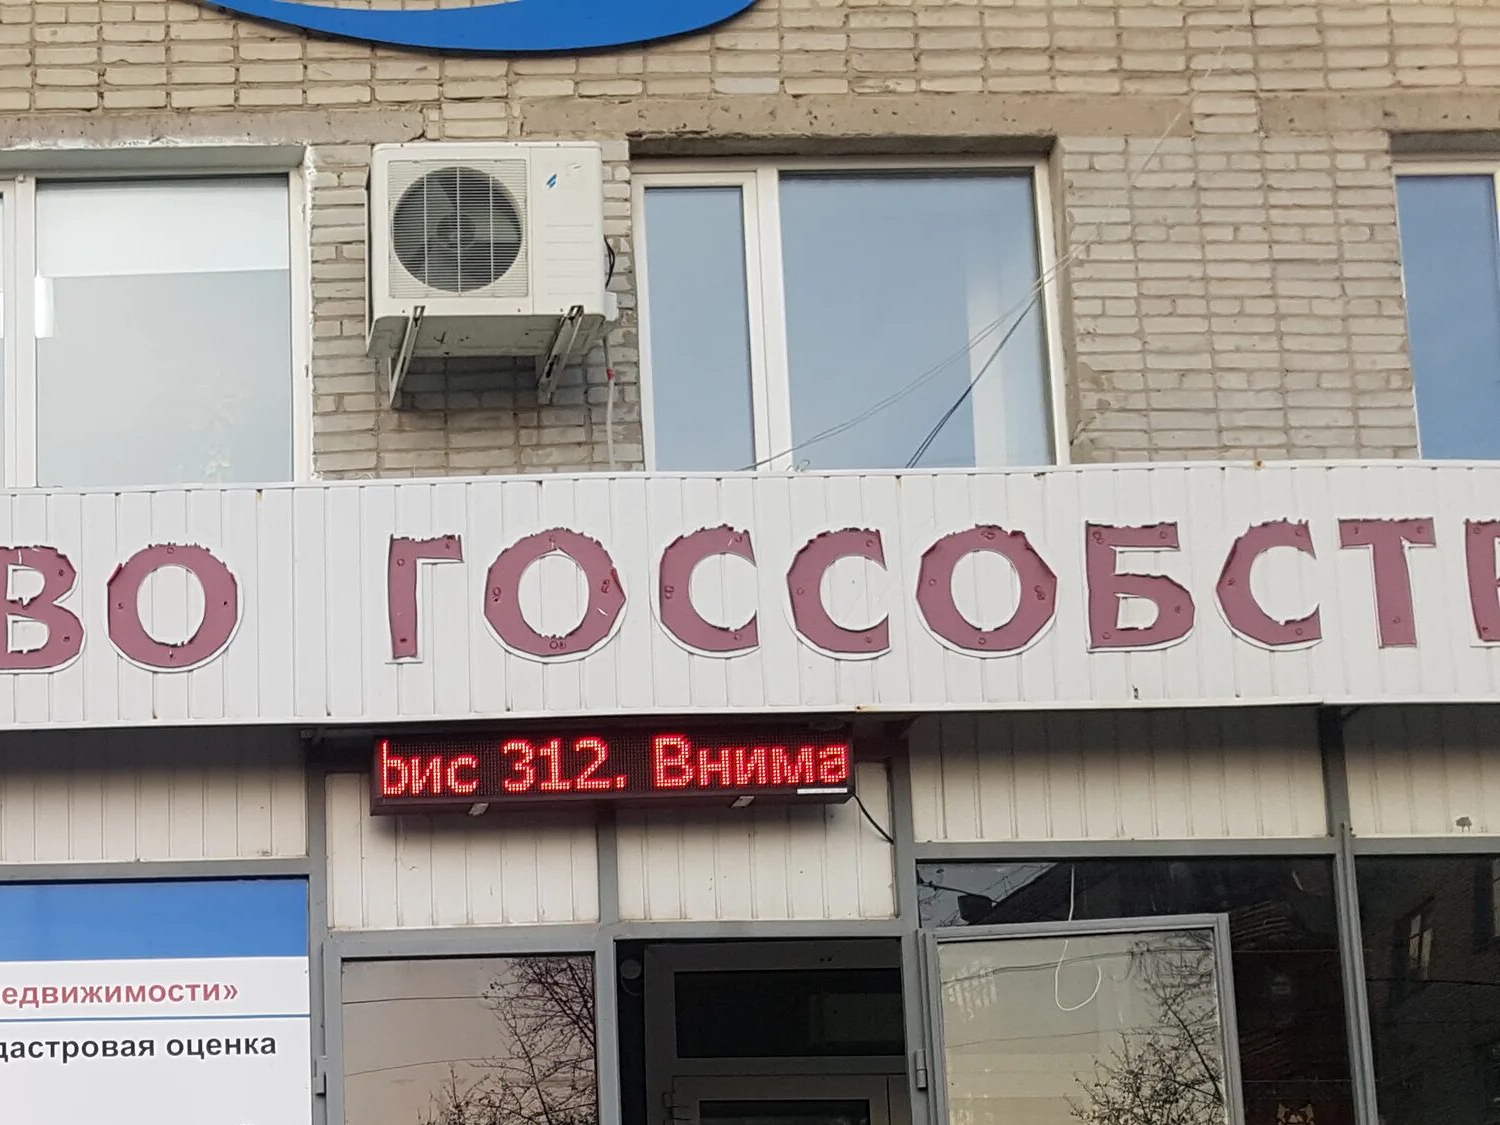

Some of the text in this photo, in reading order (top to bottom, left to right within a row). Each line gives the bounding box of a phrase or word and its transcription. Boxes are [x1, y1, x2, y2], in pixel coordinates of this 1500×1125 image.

[503, 737, 628, 792] 312.
[653, 736, 850, 790] Внима
[166, 1034, 277, 1060] оценка
